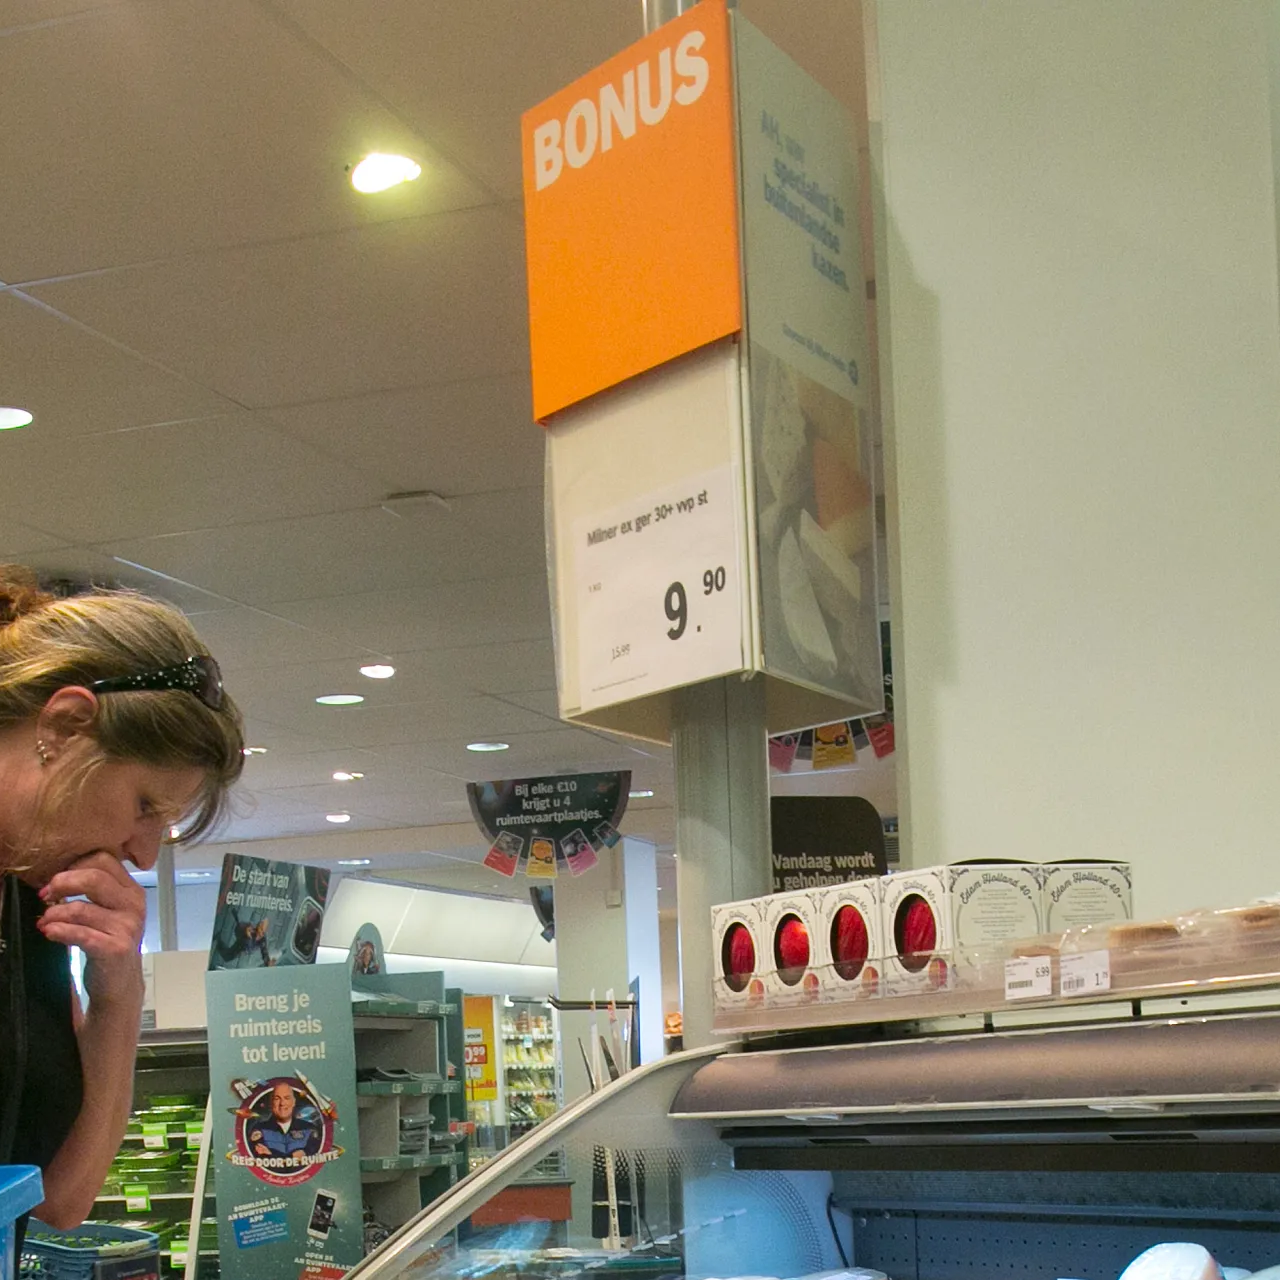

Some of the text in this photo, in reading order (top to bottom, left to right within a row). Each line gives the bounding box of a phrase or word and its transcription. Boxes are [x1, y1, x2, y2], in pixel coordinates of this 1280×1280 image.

[534, 31, 709, 191] BONUS
[587, 526, 618, 547] Milner
[620, 519, 633, 534] ex
[635, 513, 652, 533] ger
[654, 503, 674, 523] 30+
[697, 489, 709, 506] st
[515, 781, 577, 796] Bij elke €10
[522, 796, 570, 811] krijgt u 4
[496, 809, 602, 826] ruimtevaartplaatjes.
[772, 852, 875, 872] Vandaag wordt
[232, 865, 290, 889] De start van
[1050, 879, 1072, 902] Edam
[1072, 872, 1109, 886] Holland
[960, 880, 982, 904] Edam
[982, 873, 1020, 888] Holland
[226, 891, 293, 912] een ruimtereis.
[234, 989, 310, 1012] Breng je
[230, 1014, 322, 1038] ruimtereis
[242, 1042, 326, 1063] tot leven!
[256, 1156, 284, 1168] DOOR
[286, 1157, 299, 1167] DE
[249, 1215, 265, 1223] APP
[305, 1251, 323, 1260] OPEN
[305, 1258, 356, 1271] RUIMTEVAART
